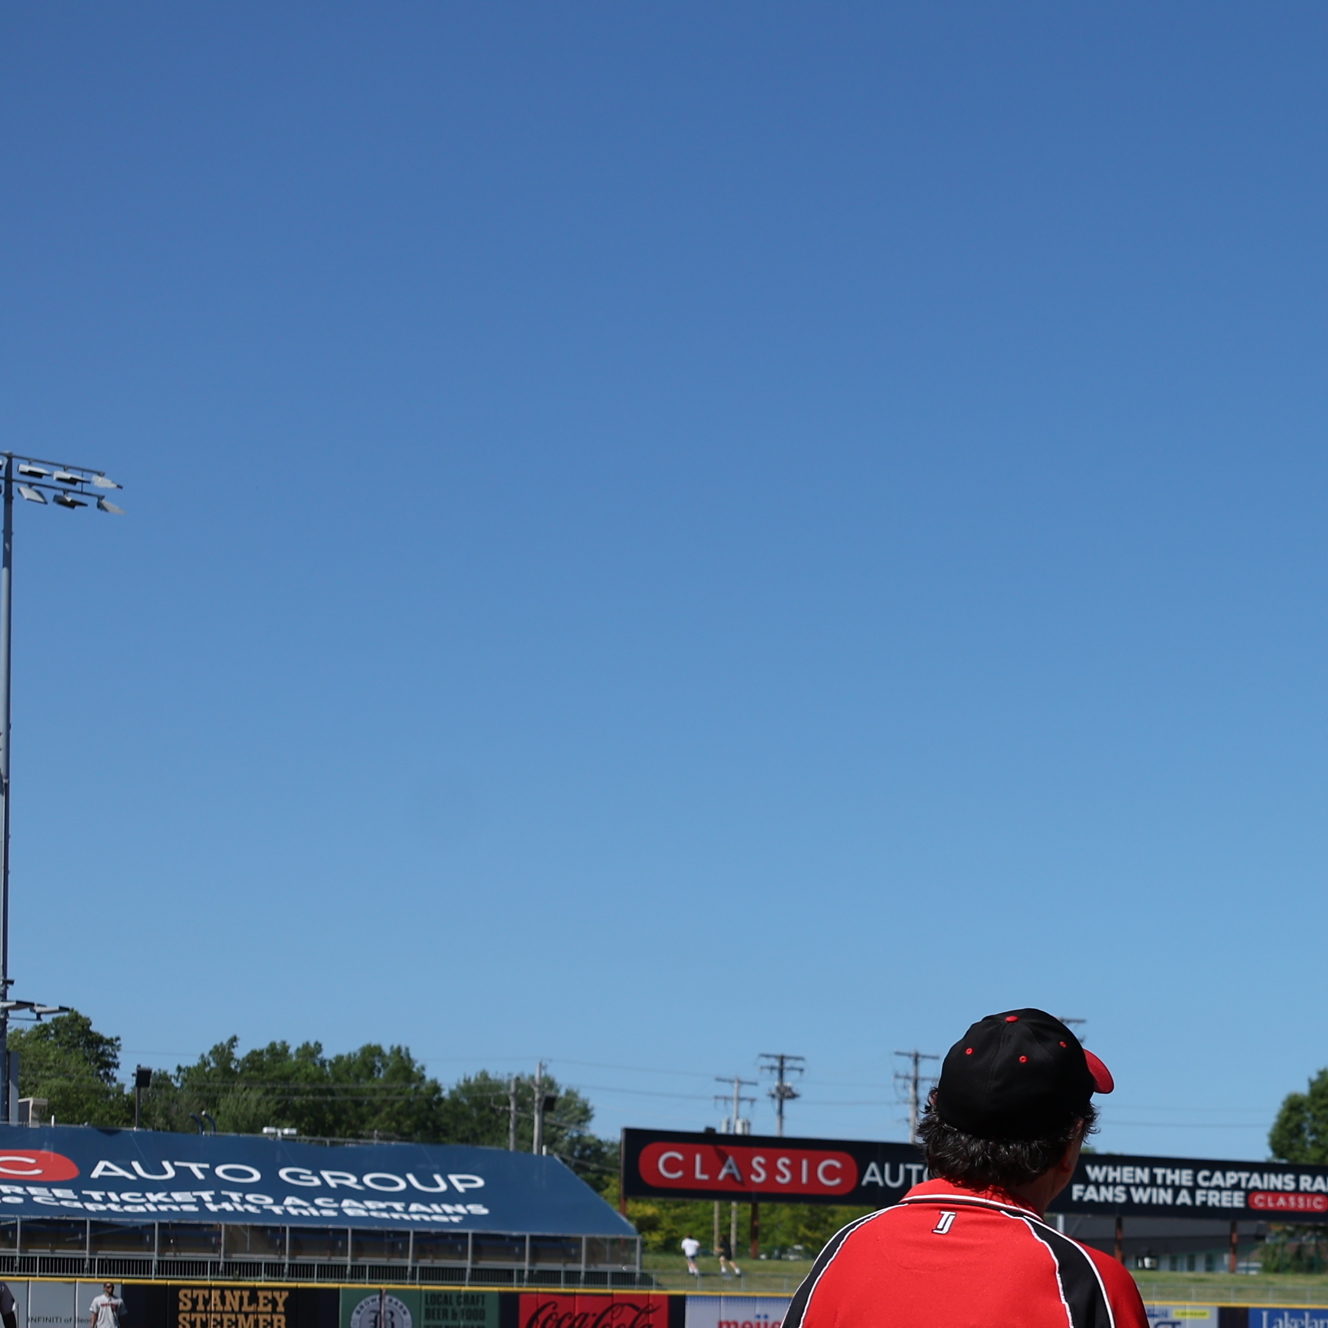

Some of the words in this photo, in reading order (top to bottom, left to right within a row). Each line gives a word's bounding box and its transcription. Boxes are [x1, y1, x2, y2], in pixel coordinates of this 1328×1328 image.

[90, 1160, 262, 1183] AUTO
[278, 1167, 485, 1193] GROUP
[657, 1151, 843, 1186] CLASSIC
[860, 1161, 930, 1188] AUT
[1085, 1165, 1150, 1184] WHEN
[1152, 1168, 1193, 1186] THE
[1197, 1170, 1296, 1192] CAPTAINS
[32, 1196, 199, 1212] Captains
[205, 1201, 261, 1213] Hit
[263, 1204, 338, 1217] This
[342, 1208, 464, 1223] Banner
[82, 1190, 215, 1203] TICKET
[221, 1190, 274, 1205] TO
[283, 1196, 310, 1206] A
[314, 1197, 490, 1215] CAPTAINS
[1072, 1184, 1127, 1204] FANS
[1130, 1187, 1173, 1205] WIN
[1176, 1189, 1193, 1206] A
[1195, 1190, 1245, 1208] FREE
[1254, 1195, 1325, 1210] CLASSIC
[178, 1288, 289, 1312] STANLEY
[425, 1294, 454, 1306] LOCAL
[456, 1294, 486, 1306] CRAFT
[425, 1308, 448, 1320] BEER
[461, 1308, 486, 1321] FOOD
